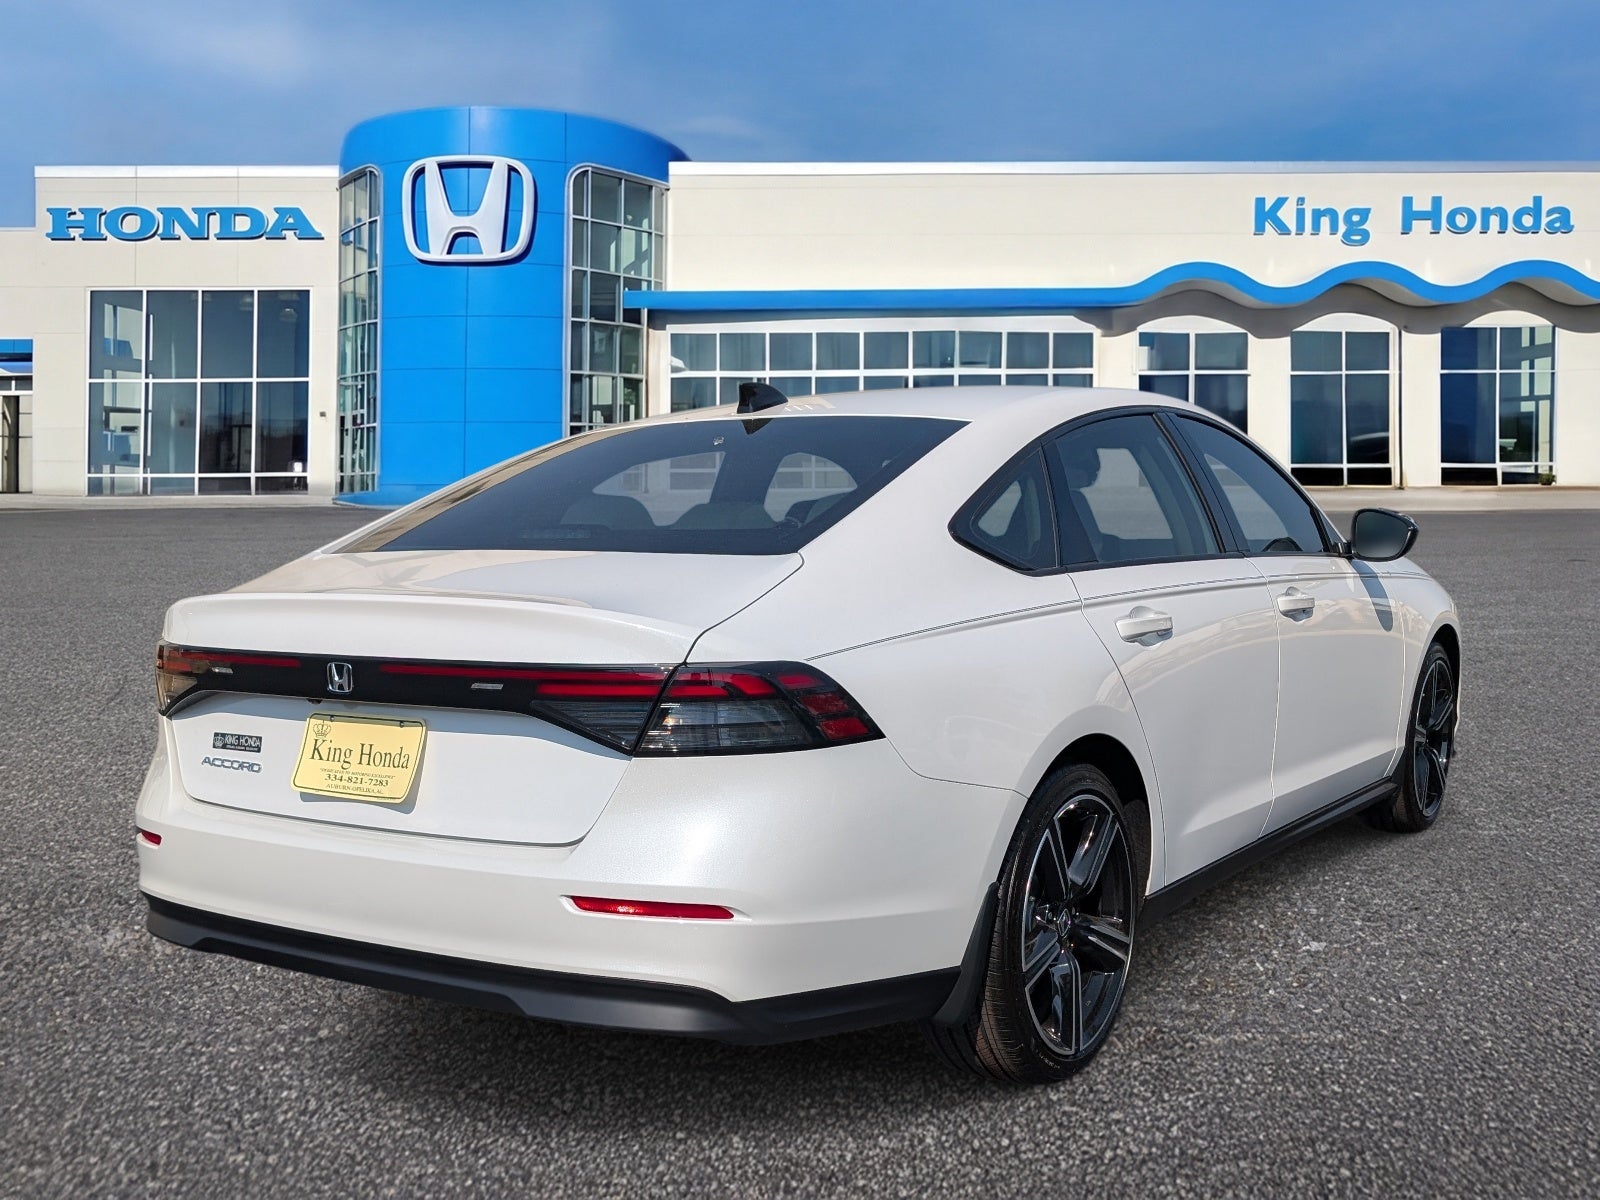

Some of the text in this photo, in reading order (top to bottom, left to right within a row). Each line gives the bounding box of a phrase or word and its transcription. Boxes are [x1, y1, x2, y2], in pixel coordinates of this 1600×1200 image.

[46, 206, 324, 241] HONDA
[1252, 195, 1575, 247] King Honda
[225, 734, 239, 746] KING
[239, 735, 261, 748] HONDA
[201, 756, 262, 774] ACCORD
[309, 738, 410, 771] King Honda
[324, 773, 389, 787] 334-821-7283
